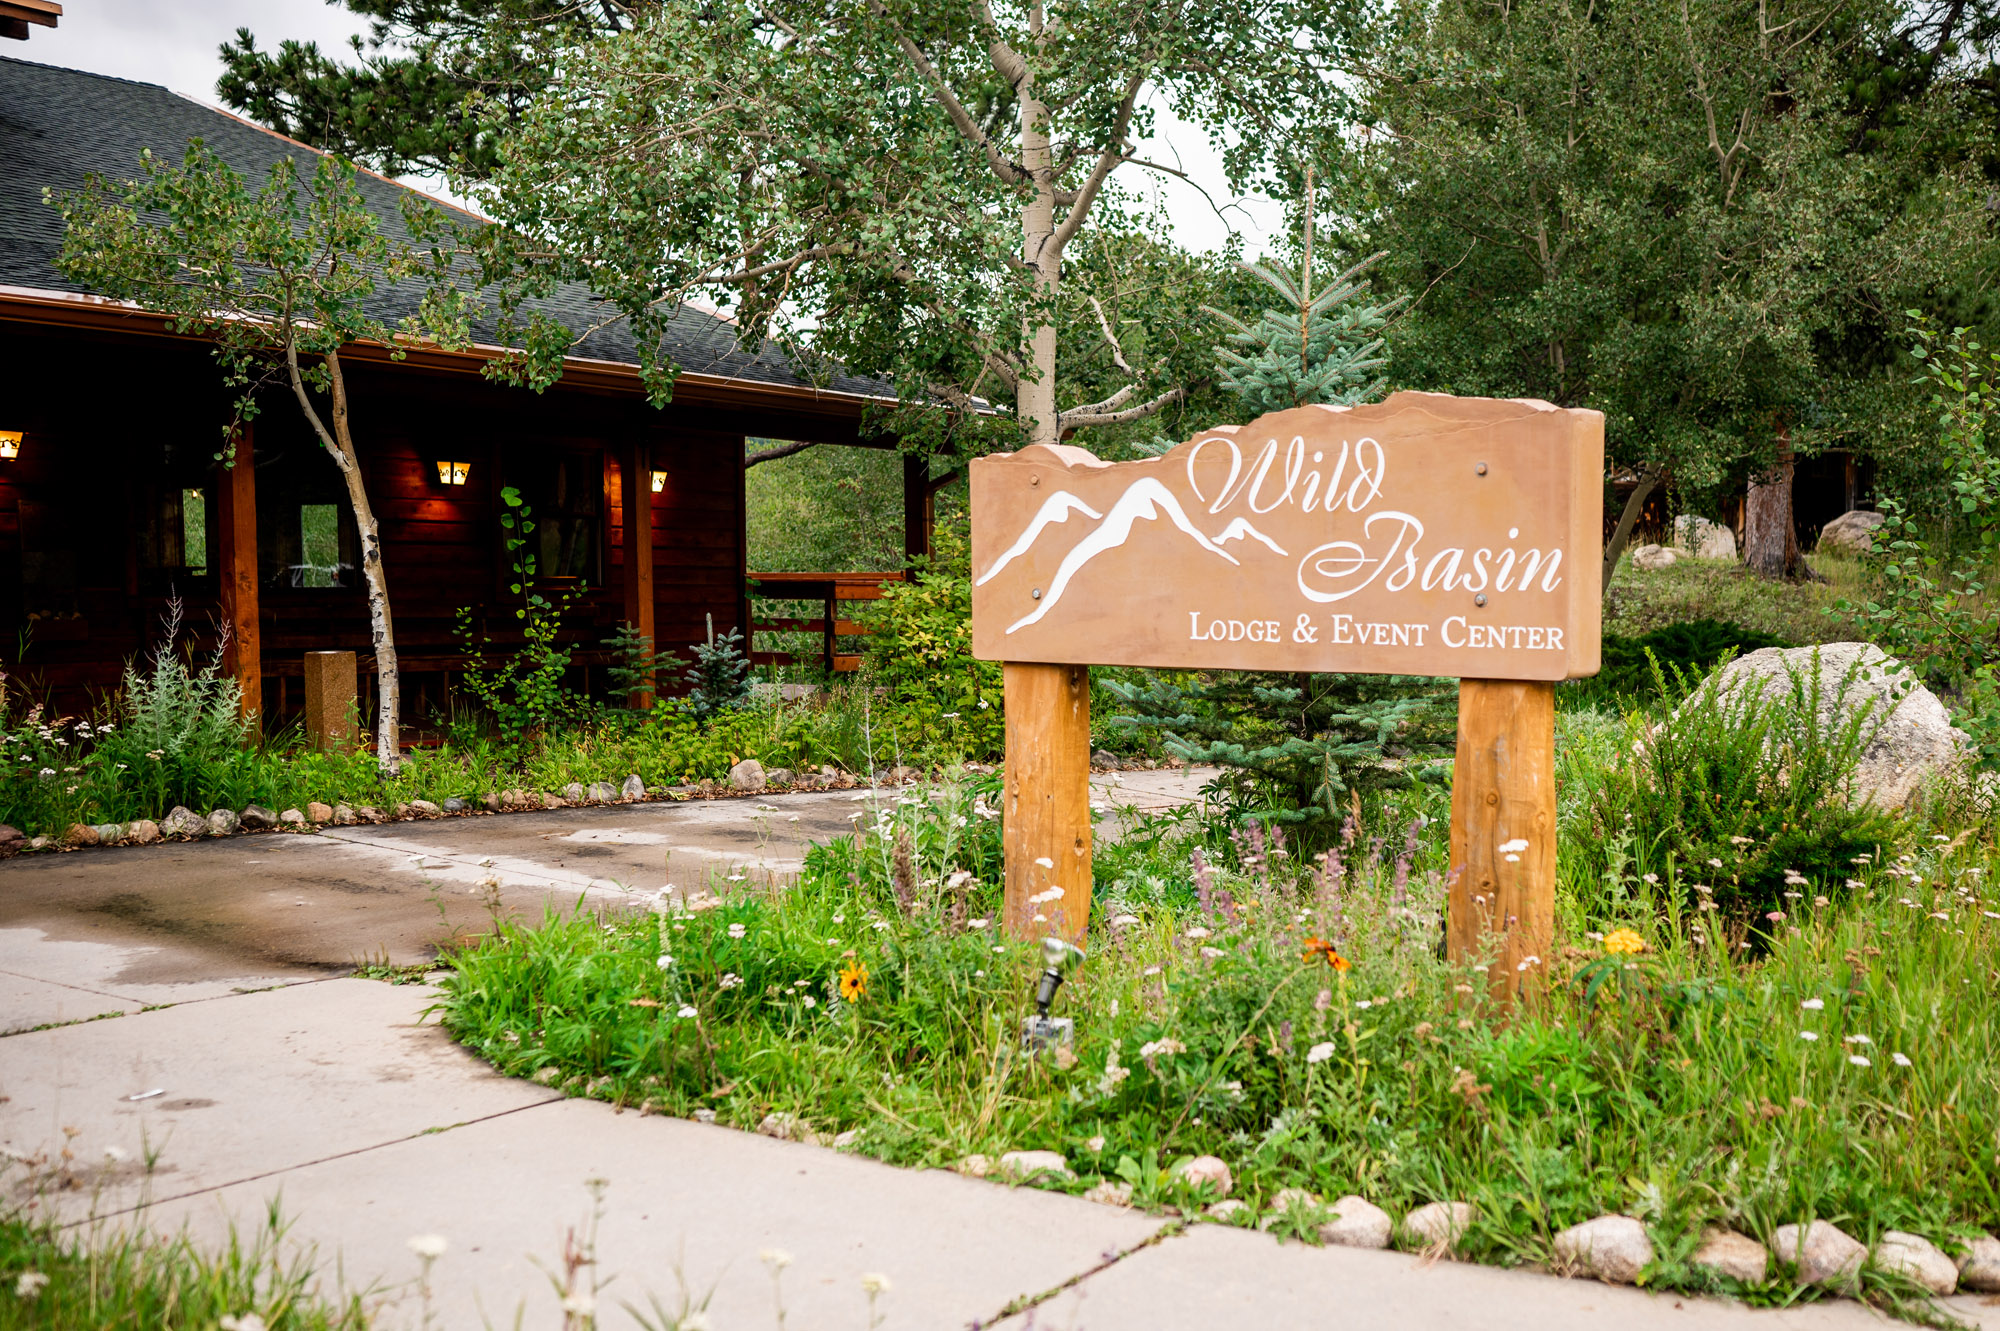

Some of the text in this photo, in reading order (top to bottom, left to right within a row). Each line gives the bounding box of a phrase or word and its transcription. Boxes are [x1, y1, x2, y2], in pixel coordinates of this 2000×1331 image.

[1186, 435, 1386, 515] Wild
[1297, 510, 1564, 604] Basin
[1188, 611, 1565, 650] LODGE & EVENT CENTER
